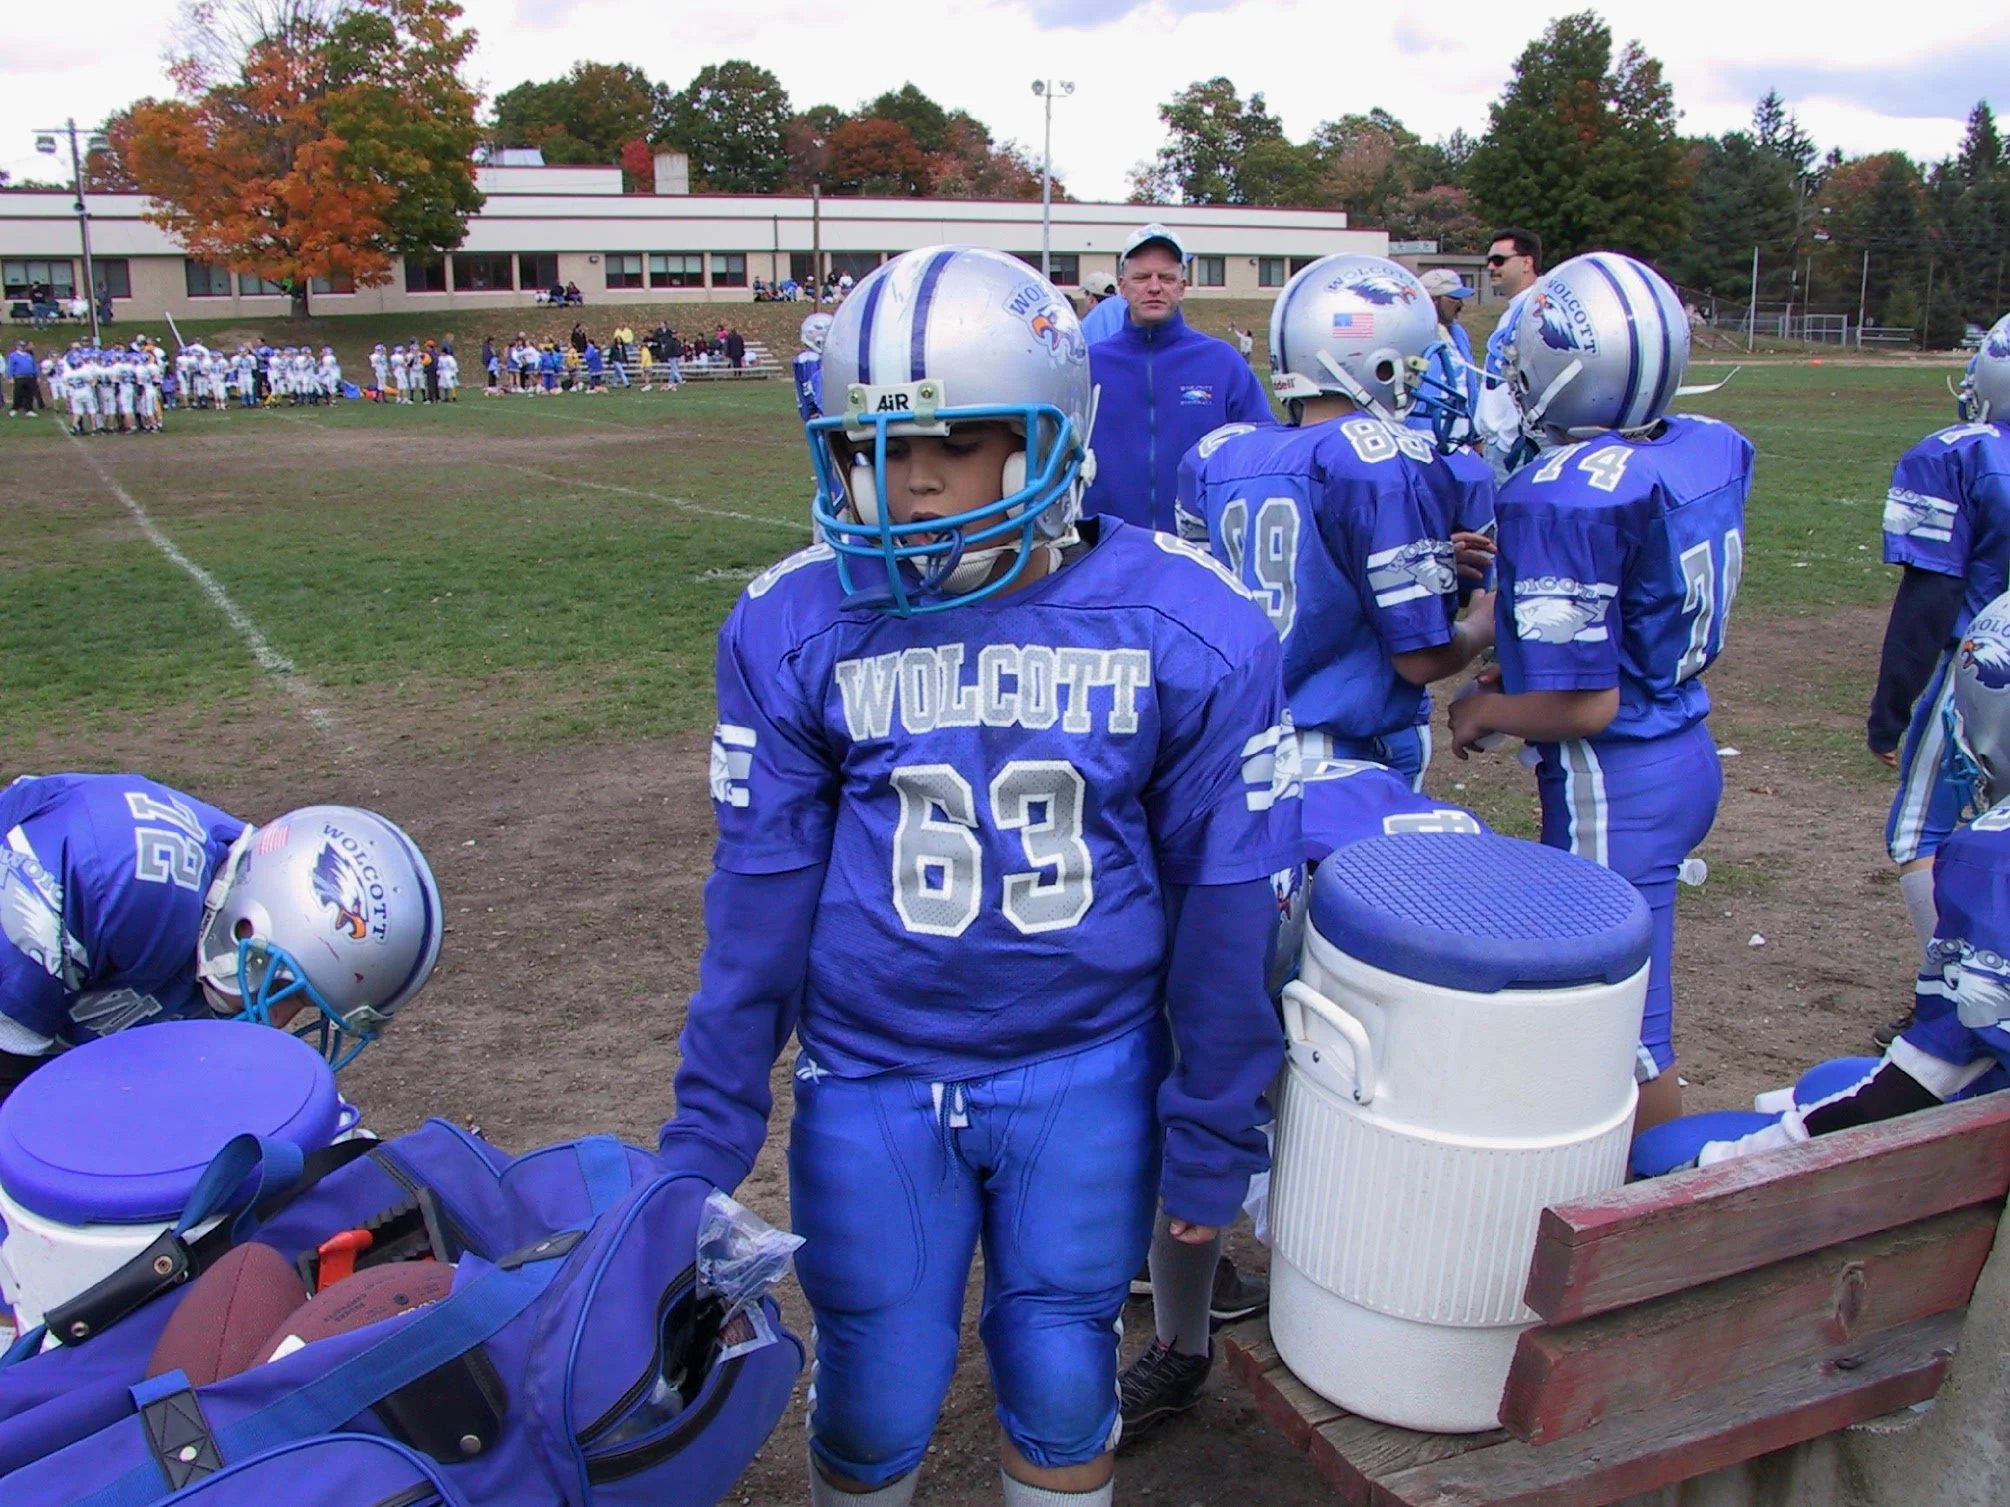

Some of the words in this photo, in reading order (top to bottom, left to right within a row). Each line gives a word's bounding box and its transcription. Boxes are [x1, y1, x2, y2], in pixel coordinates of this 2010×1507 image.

[1532, 441, 1636, 493] 74
[836, 644, 1153, 741] WOLCOTT
[322, 823, 388, 941] WOLCOTT
[889, 760, 1095, 937] 63
